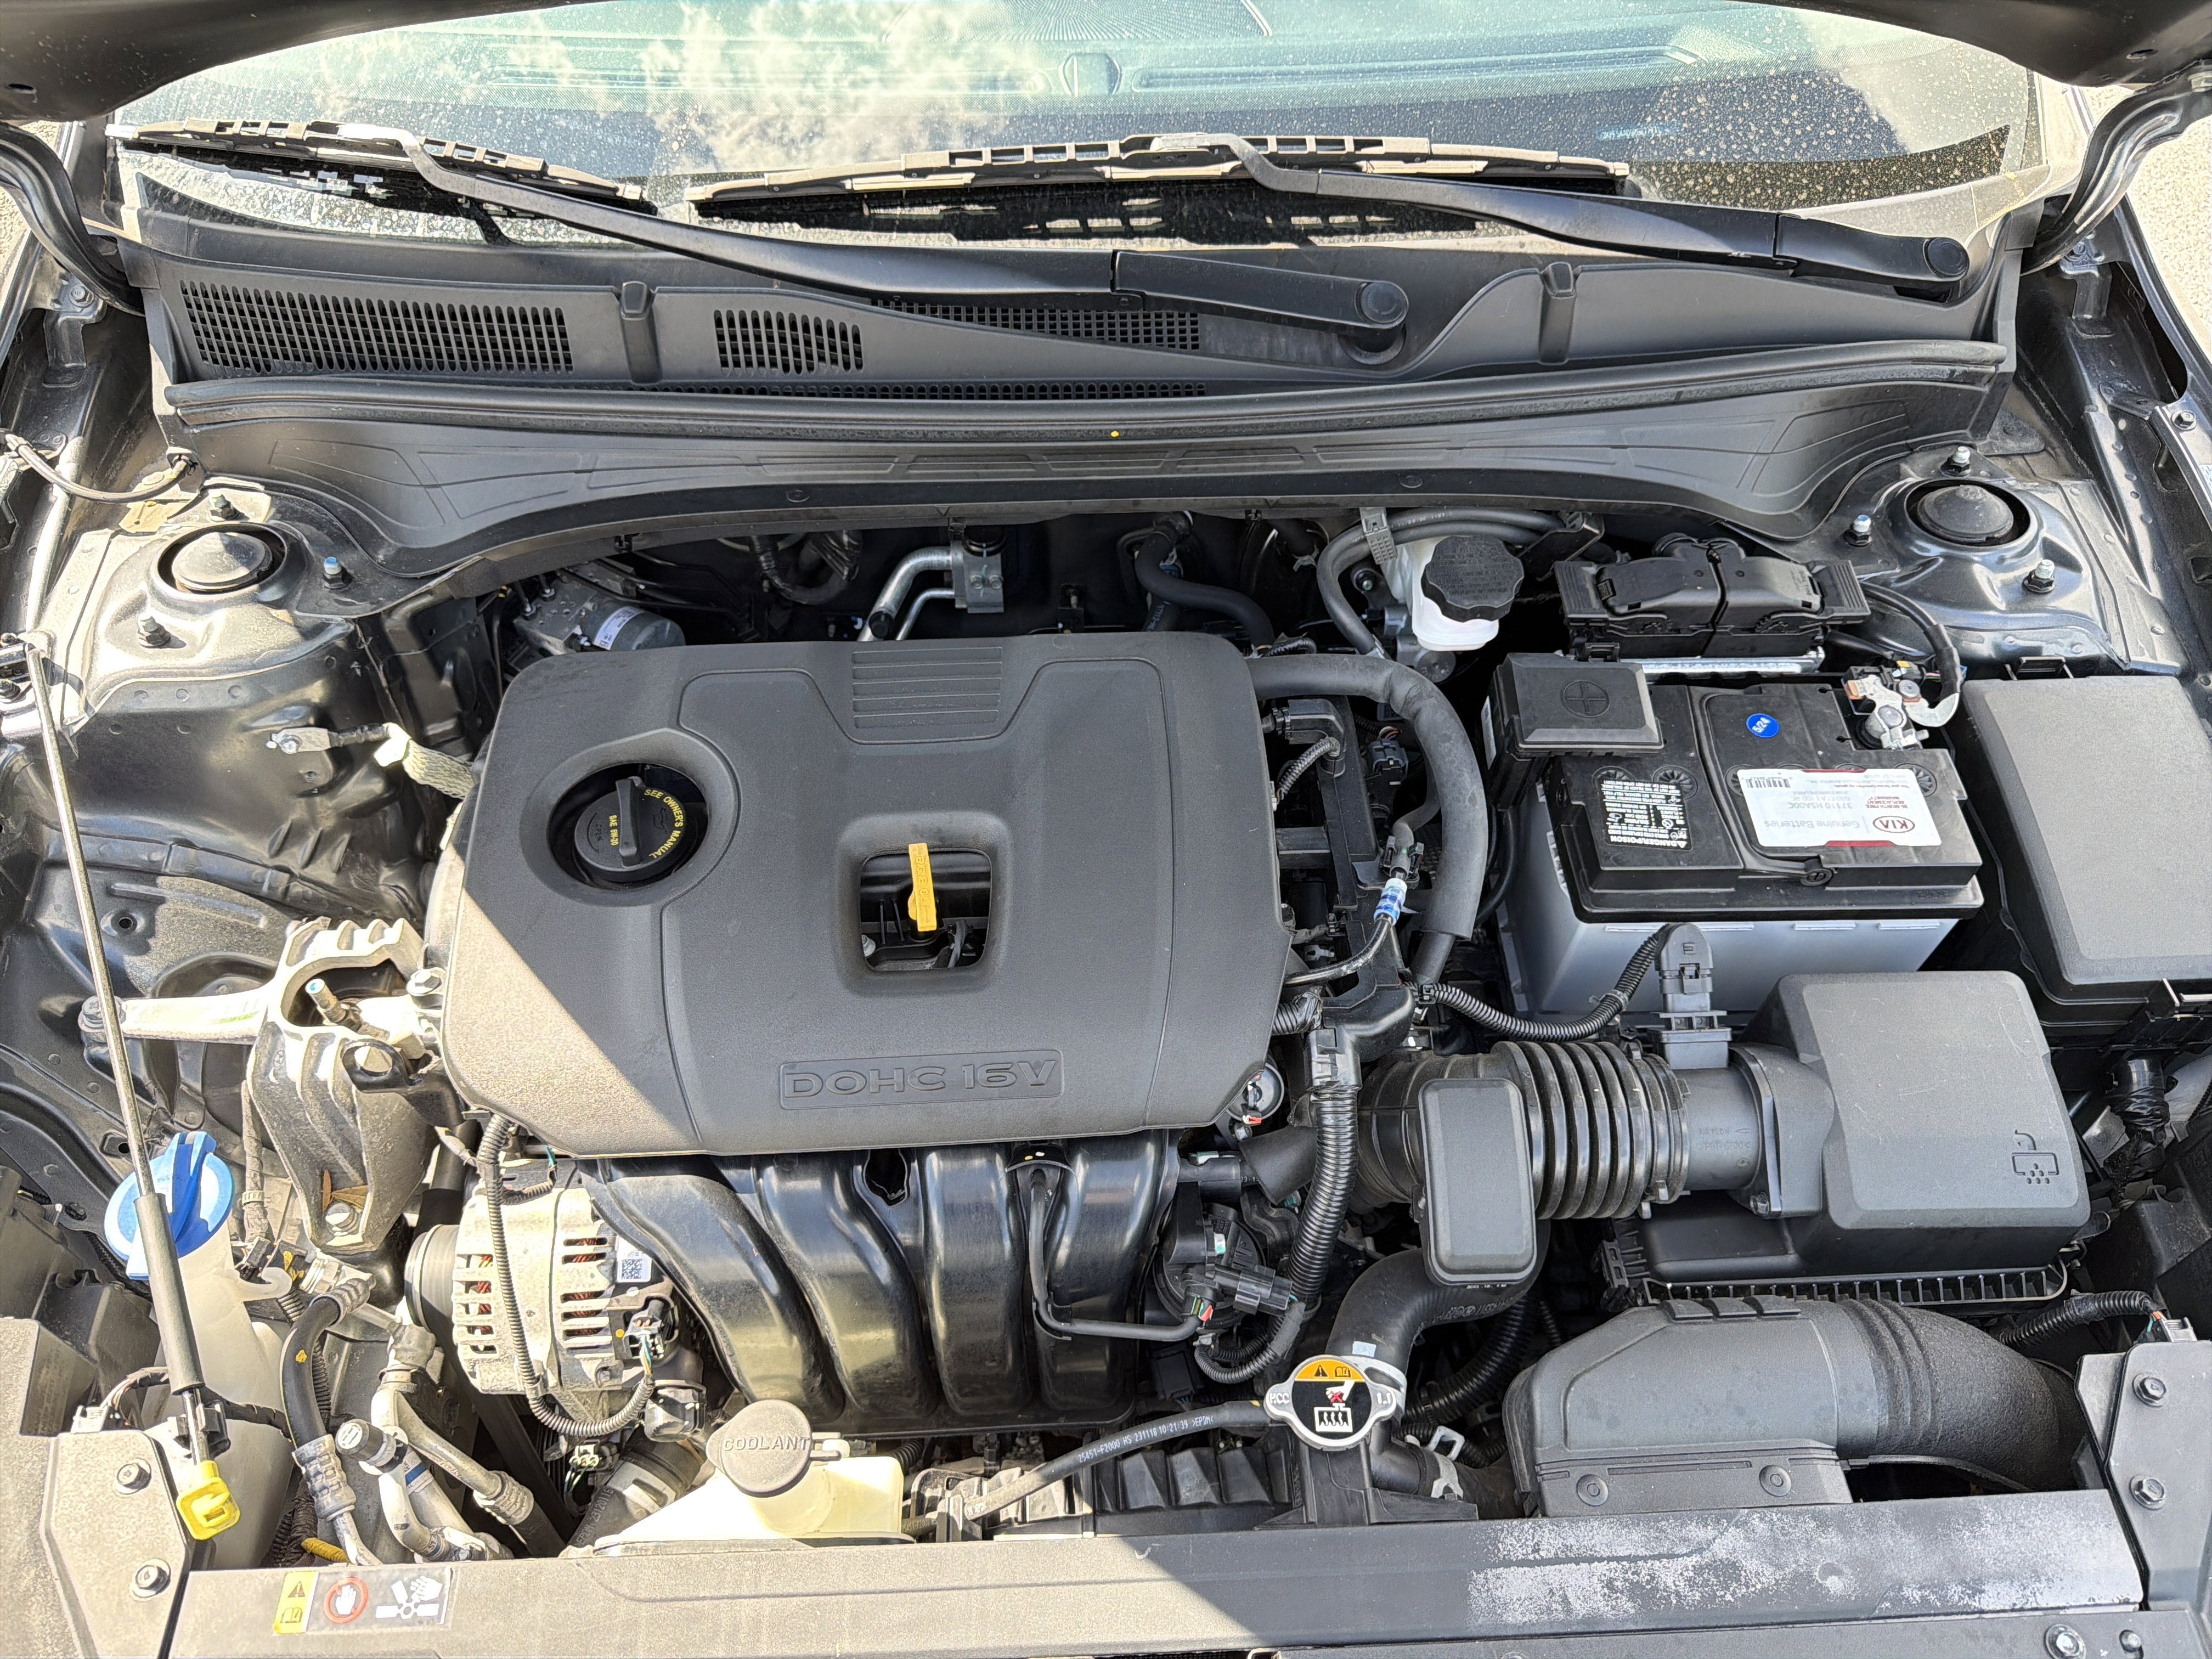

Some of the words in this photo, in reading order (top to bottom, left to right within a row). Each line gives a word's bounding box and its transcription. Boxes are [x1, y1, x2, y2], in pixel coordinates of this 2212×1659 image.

[1752, 717, 1770, 733] 5/24
[644, 789, 664, 799] SEE
[663, 796, 684, 828] OWNER'S
[608, 815, 618, 827] SAE
[1879, 820, 1909, 829] KIA
[610, 828, 619, 846] 5W-20
[648, 830, 682, 859] MANUAL
[1611, 836, 1677, 847] DANGER/POISON
[785, 1066, 946, 1098] DOHC
[962, 1059, 1057, 1089] 16V
[1376, 1393, 1391, 1404] 1.1
[724, 1436, 810, 1451] COOLANT
[1077, 1439, 1120, 1463] 25451-F2000
[1134, 1427, 1158, 1442] 231118
[1159, 1420, 1188, 1435] 10:21:39
